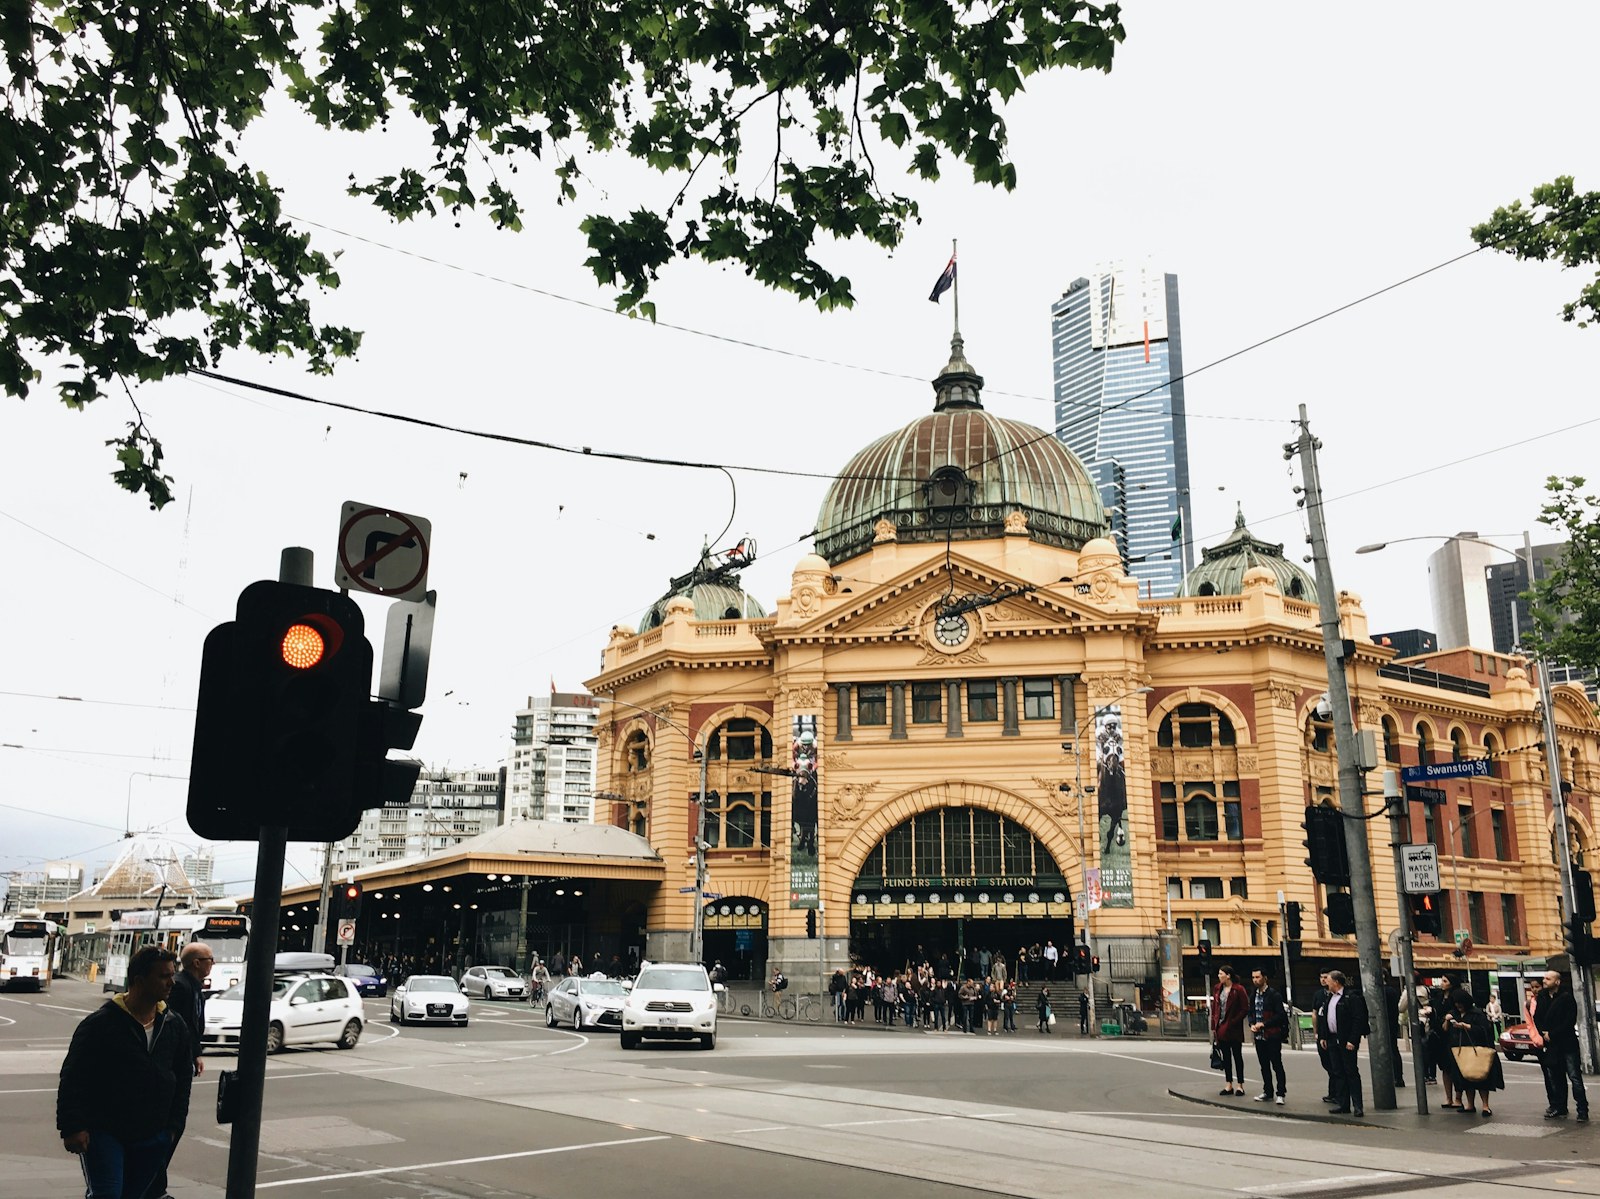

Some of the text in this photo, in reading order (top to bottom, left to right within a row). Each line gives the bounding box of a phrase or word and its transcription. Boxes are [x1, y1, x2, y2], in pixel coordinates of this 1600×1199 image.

[1426, 762, 1474, 775] Swanston
[1475, 760, 1487, 771] St
[1408, 864, 1433, 872] WATCH
[883, 877, 1034, 888] FLINDERS STREET STATION
